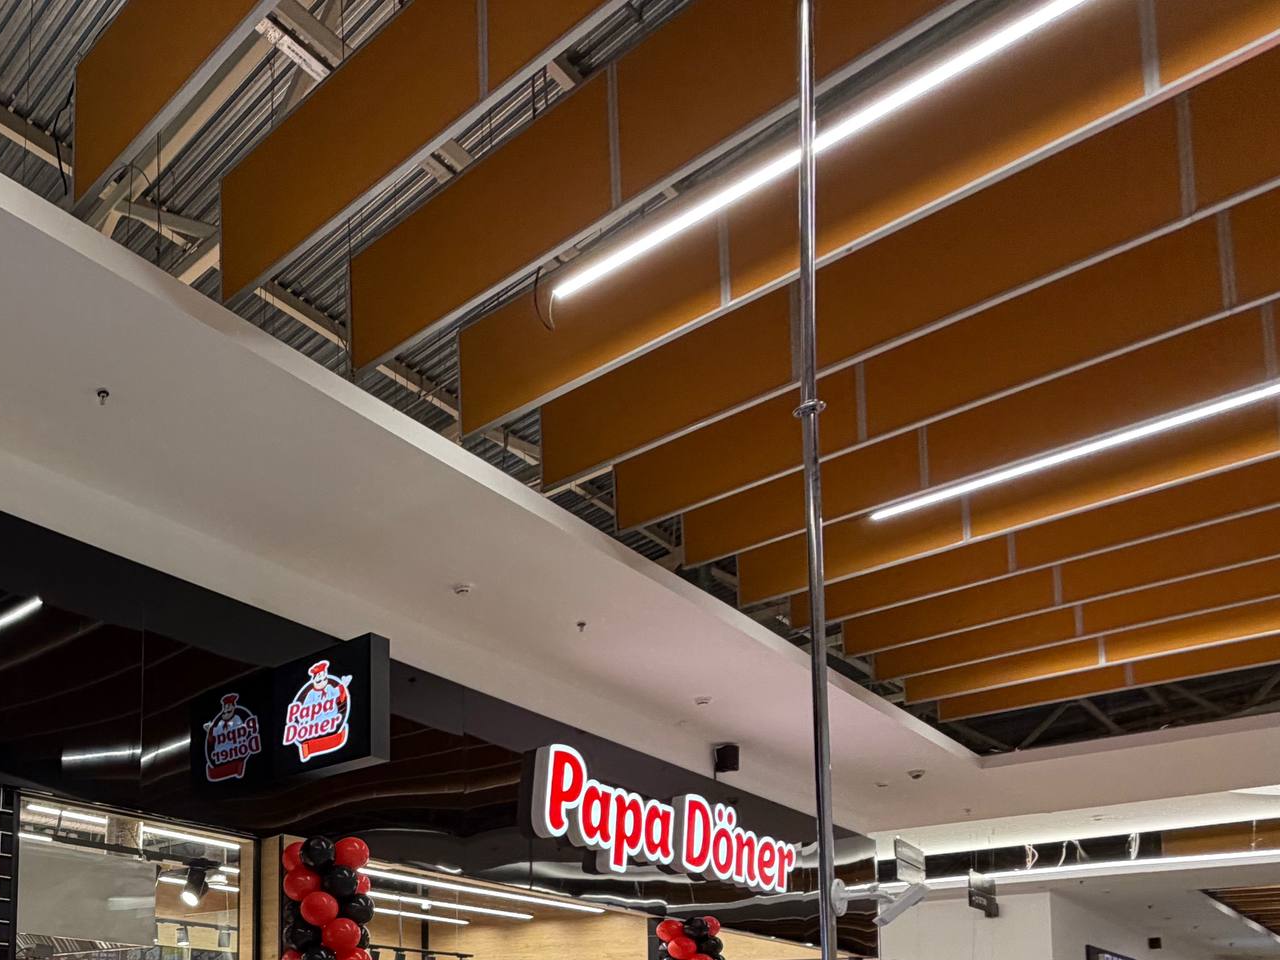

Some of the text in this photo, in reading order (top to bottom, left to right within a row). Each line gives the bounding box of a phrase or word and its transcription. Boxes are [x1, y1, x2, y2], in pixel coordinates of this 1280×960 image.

[288, 697, 334, 724] Papa
[284, 715, 340, 743] Döner
[547, 745, 795, 891] Papa Döner
